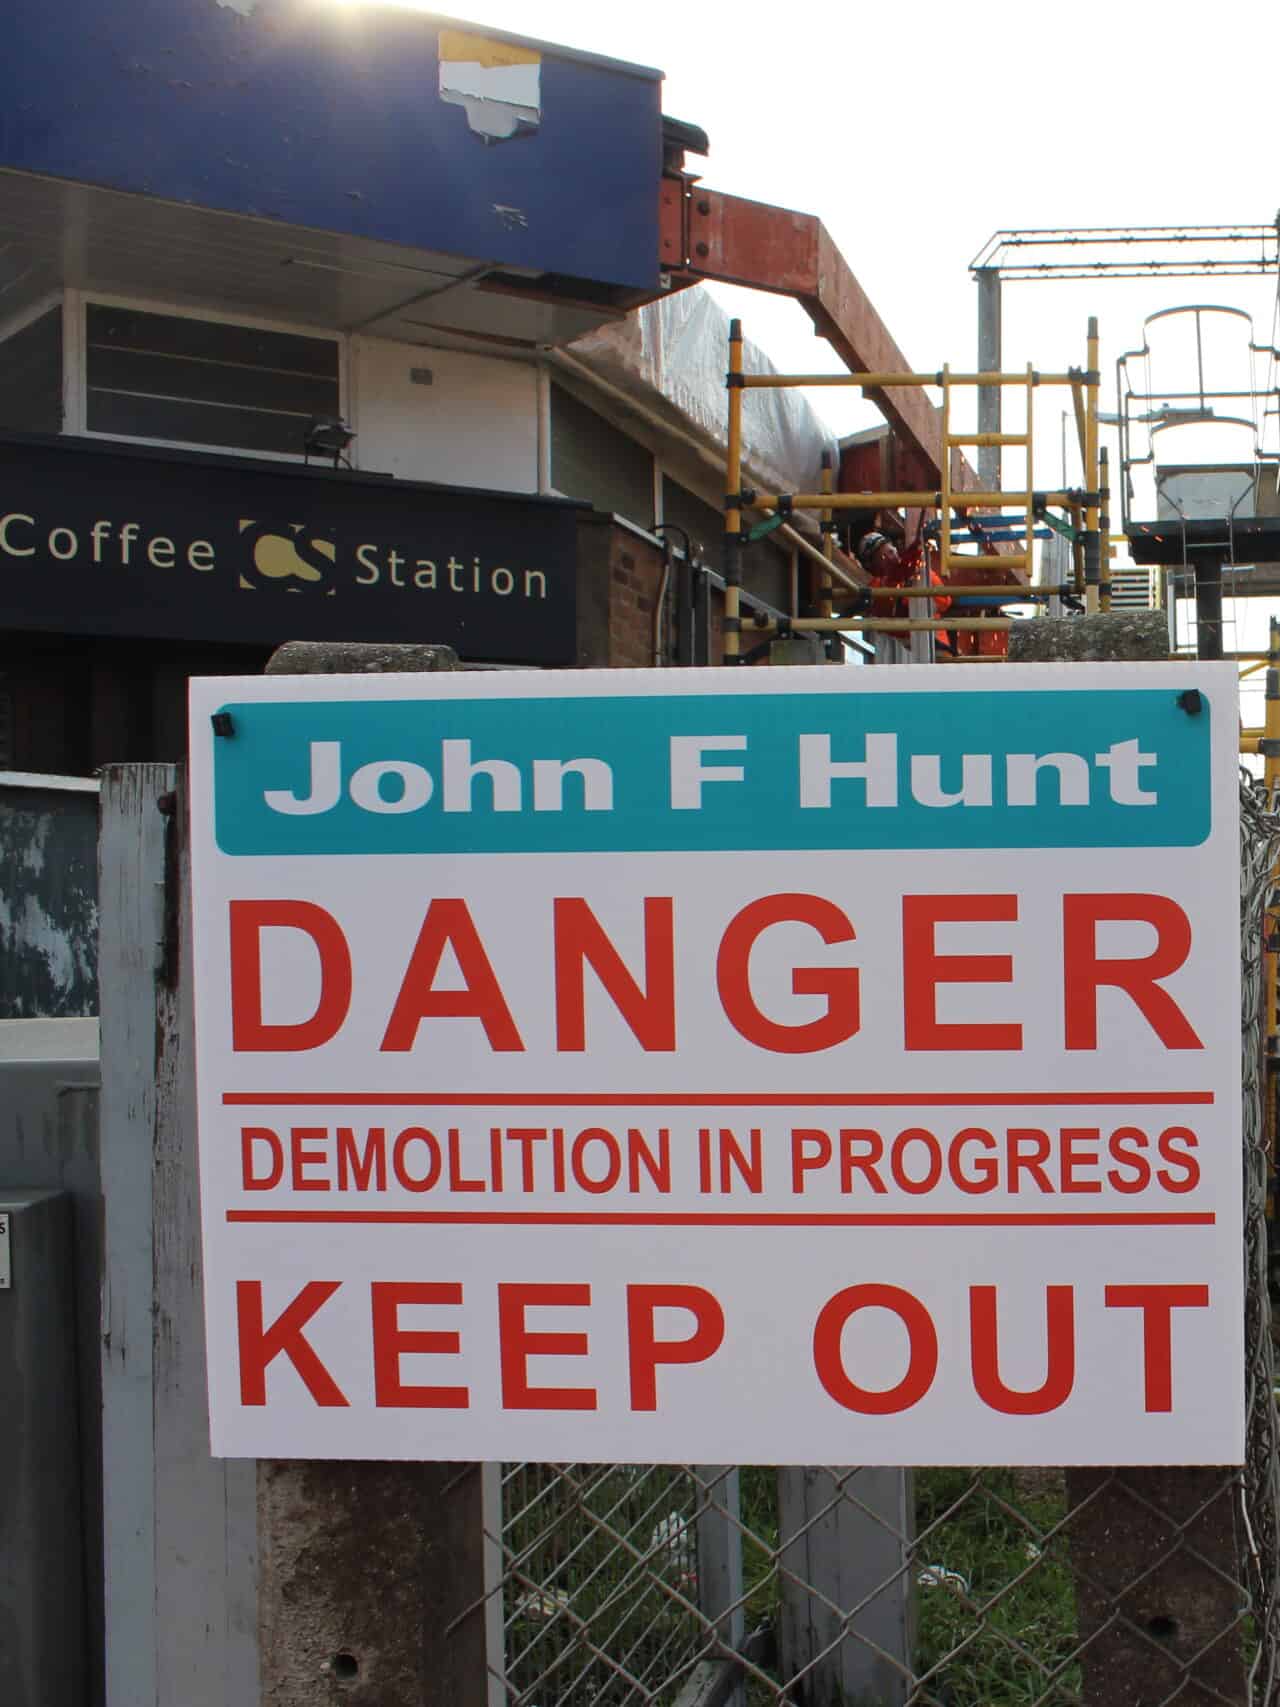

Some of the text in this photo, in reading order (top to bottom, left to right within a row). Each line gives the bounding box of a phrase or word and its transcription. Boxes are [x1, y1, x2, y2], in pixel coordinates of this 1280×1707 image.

[0, 513, 215, 571] Coffee
[356, 544, 546, 598] Station
[264, 732, 1157, 815] John F Hunt
[229, 892, 1205, 1053] DANGER
[240, 1126, 1201, 1195] DEMOLITION IN PROGRESS
[237, 1279, 1210, 1415] KEEP OUT
